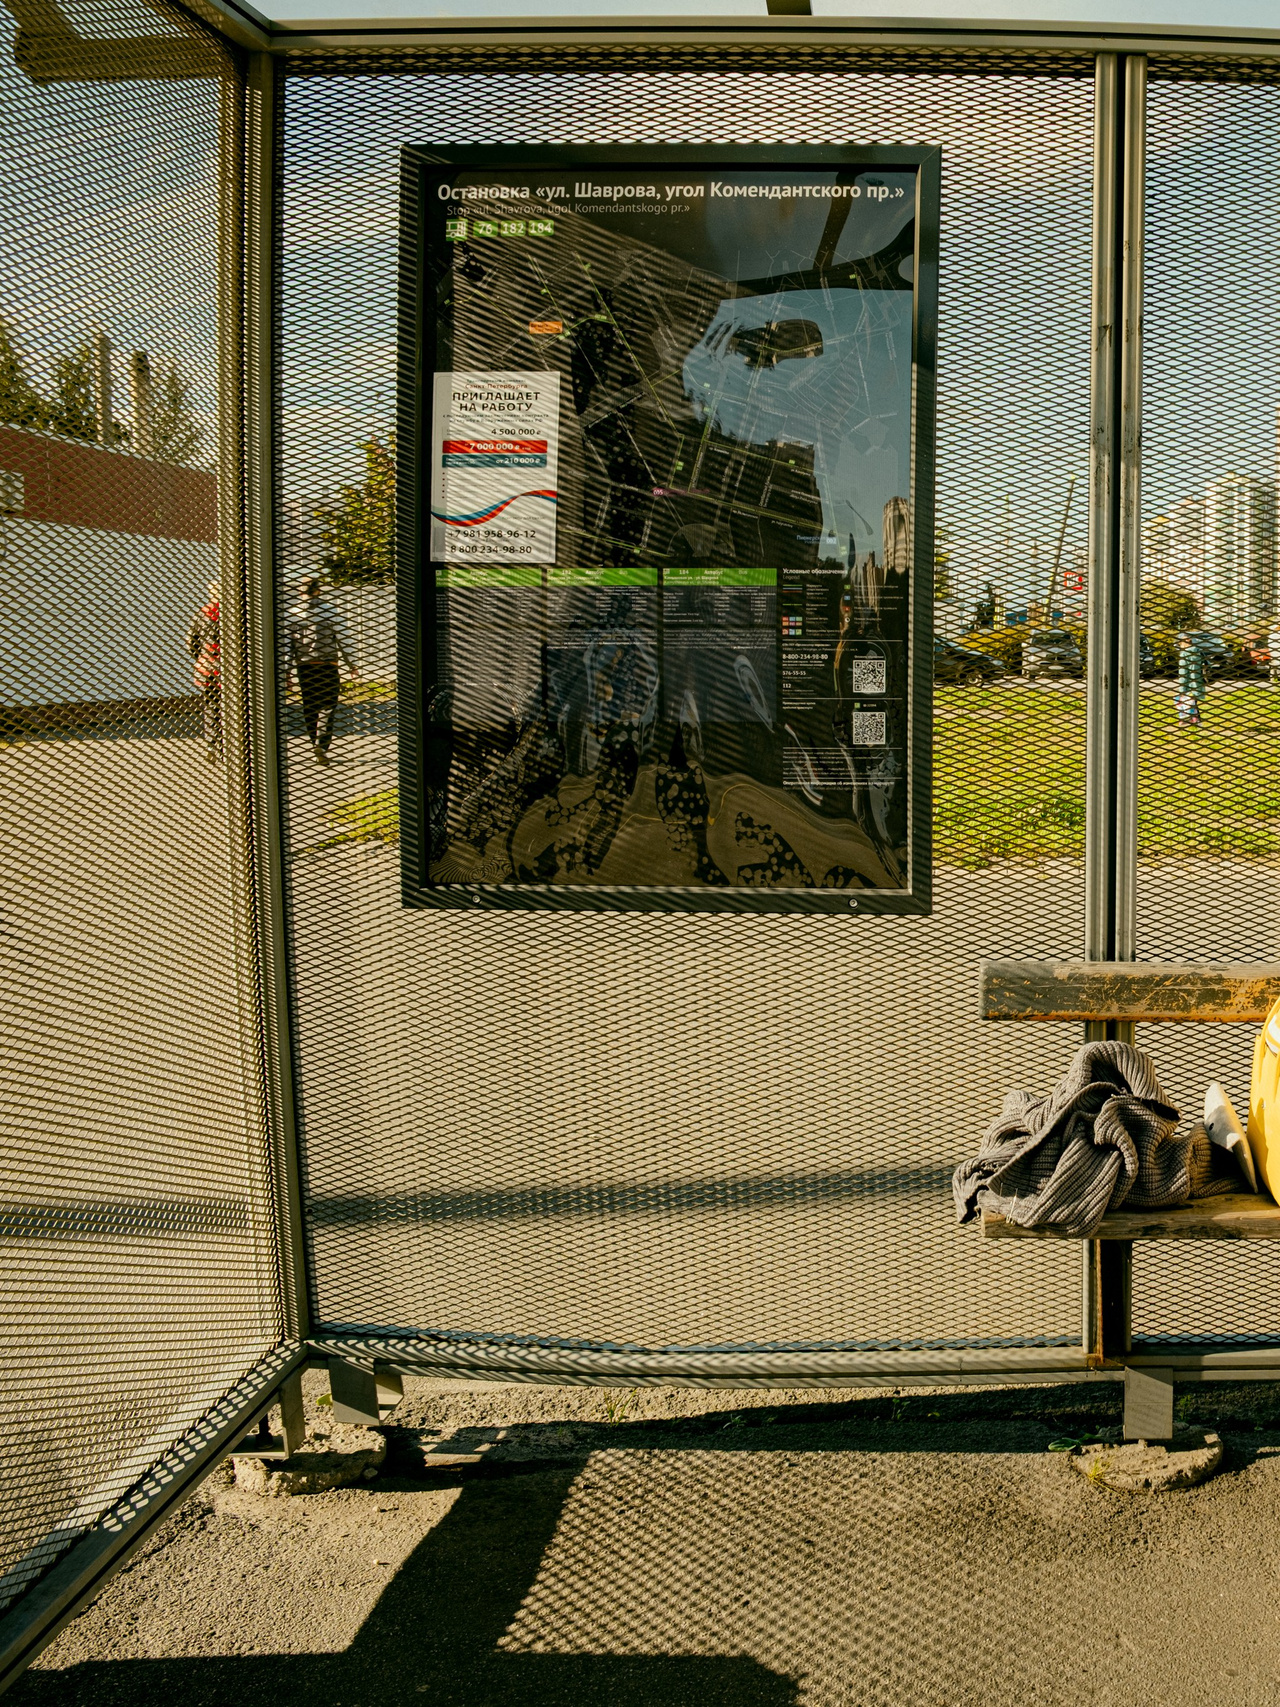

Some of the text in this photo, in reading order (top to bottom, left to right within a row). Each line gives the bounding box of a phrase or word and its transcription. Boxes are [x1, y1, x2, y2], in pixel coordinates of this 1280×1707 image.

[437, 182, 904, 202] Остановка «ул. Шаврова, угол Комендантского пр.»
[447, 205, 470, 217] Stop
[494, 204, 545, 215] Shavrova,
[547, 203, 572, 216] ugol
[574, 203, 668, 216] Komendantskogo
[670, 204, 690, 215] pr.»
[478, 221, 552, 234] 76 182 184
[452, 392, 540, 401] ПРИГЛАШАЕТ
[459, 402, 533, 412] НА РАБОТУ
[448, 529, 536, 538] +7 981 958-96-12
[450, 545, 532, 554] 8 800 234-98-80
